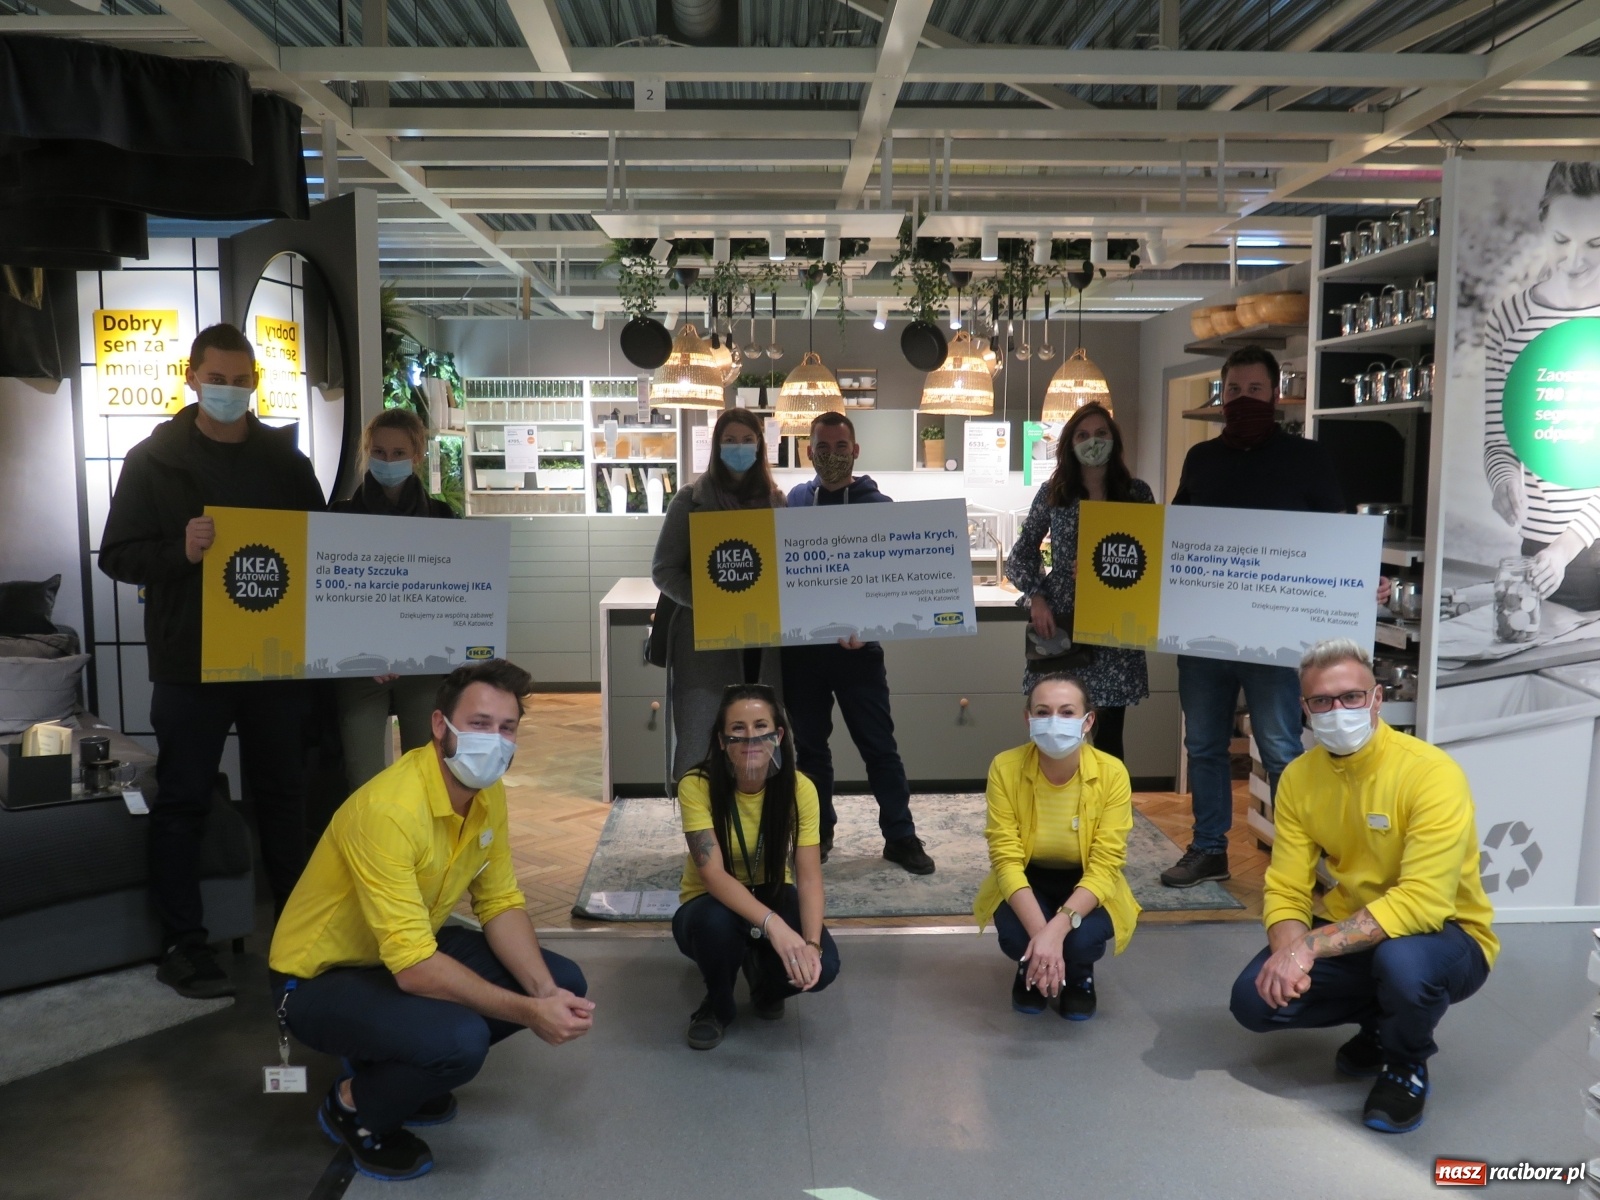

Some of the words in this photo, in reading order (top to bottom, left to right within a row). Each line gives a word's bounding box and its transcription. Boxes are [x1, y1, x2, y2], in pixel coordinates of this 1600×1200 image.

[646, 89, 654, 100] 2
[103, 314, 162, 335] Dobry
[104, 340, 136, 352] sen
[144, 340, 164, 352] za
[106, 360, 158, 380] mniej
[108, 387, 177, 409] 2000,-
[784, 537, 828, 549] Nagroda
[831, 535, 868, 547] główna
[871, 533, 886, 542] dla
[889, 531, 921, 541] Pawła
[924, 529, 958, 541] Krych,
[716, 549, 753, 562] IKEA
[785, 551, 800, 562] 20
[853, 549, 885, 559] zakup
[888, 544, 955, 558] wymarzonej
[1102, 542, 1138, 558] IKEA
[1171, 540, 1211, 552] Nagroda
[1214, 544, 1224, 552] za
[1226, 545, 1259, 556] zajęcie
[1261, 547, 1267, 555] II
[1270, 548, 1307, 559] miejsca
[235, 557, 279, 573] IKEA
[316, 551, 358, 563] Nagroda
[374, 553, 405, 565] zajęcie
[407, 554, 416, 562] III
[418, 555, 451, 565] miejsca
[717, 561, 754, 569] KATOWICE
[1101, 556, 1138, 565] KATOWICE
[1171, 552, 1185, 561] dla
[1187, 553, 1228, 566] Karoliny
[1230, 556, 1260, 567] Wąsik
[316, 565, 330, 574] dla
[333, 565, 365, 578] Beaty
[367, 566, 409, 576] Szczuka
[786, 564, 823, 575] kuchni
[825, 563, 850, 573] IKEA
[1170, 564, 1182, 573] 10
[1212, 569, 1224, 577] na
[1227, 569, 1258, 579] karcie
[1260, 572, 1337, 588] podarunkowej
[1340, 578, 1364, 588] IKEA
[235, 573, 279, 581] KATOWICE
[786, 580, 795, 588] w
[798, 576, 848, 587] konkursie
[850, 575, 863, 585] 20
[866, 574, 879, 584] lat
[881, 573, 905, 583] IKEA
[907, 571, 956, 582] Katowice.
[315, 579, 322, 589] 5
[369, 580, 399, 589] karcie
[402, 581, 470, 592] podarunkowej
[471, 582, 492, 590] IKEA
[1179, 577, 1224, 589] konkursie
[1227, 581, 1239, 590] 20
[1241, 582, 1253, 591] lat
[1255, 584, 1278, 593] IKEA
[1279, 585, 1327, 598] Katowice.
[315, 594, 324, 602] w
[326, 592, 373, 602] konkursie
[375, 593, 387, 602] 20
[389, 593, 401, 602] lat
[403, 594, 423, 602] IKEA
[425, 593, 467, 603] Katowice.
[865, 590, 900, 598] Dziękujemy
[909, 588, 934, 597] wspólną
[400, 612, 435, 620] Dziękujemy
[445, 612, 469, 620] wspólną
[1251, 602, 1290, 612] Dziękujemy
[1301, 607, 1329, 616] wspólną
[1327, 617, 1358, 626] Katowice
